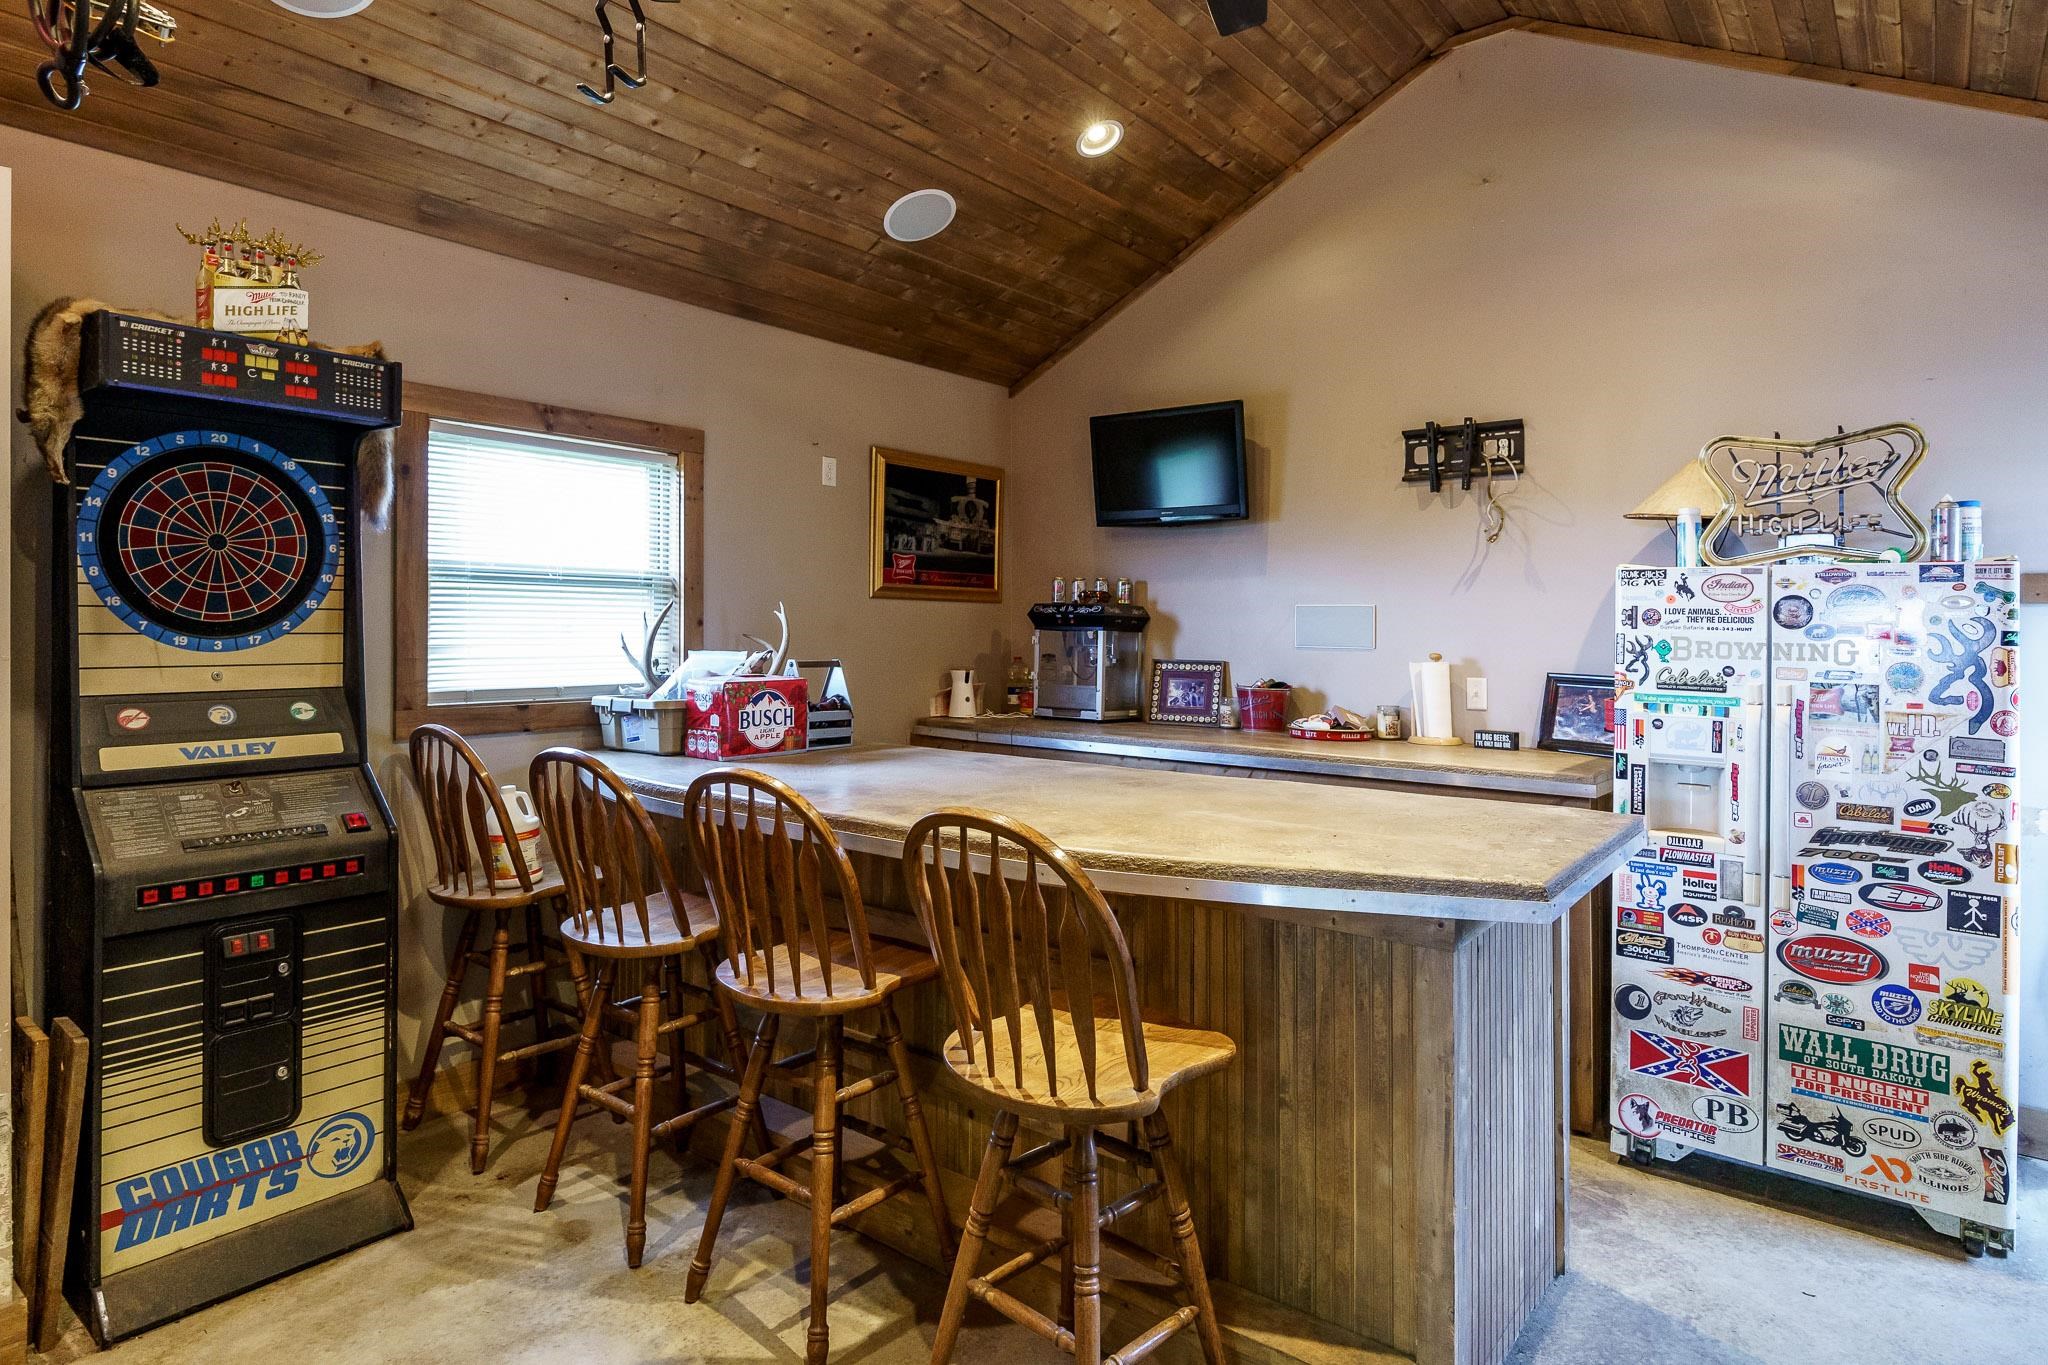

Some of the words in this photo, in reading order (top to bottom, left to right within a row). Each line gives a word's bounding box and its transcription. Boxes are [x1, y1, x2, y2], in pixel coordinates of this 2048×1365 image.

[225, 304, 264, 317] HIGH
[267, 304, 298, 316] LIFE
[130, 322, 174, 335] CRICKET
[341, 359, 376, 370] CRICKET
[176, 434, 184, 444] 5
[211, 434, 228, 443] 20
[135, 446, 150, 456] 12
[253, 444, 259, 452] 1
[282, 461, 295, 471] 18
[107, 468, 118, 478] 9
[1732, 450, 1901, 499] Miller
[308, 486, 317, 495] 4
[85, 497, 102, 506] 14
[321, 513, 334, 523] 13
[79, 532, 93, 541] 11
[329, 544, 337, 553] 6
[89, 566, 98, 576] 8
[321, 574, 334, 583] 10
[1706, 579, 1749, 590] Indian
[105, 596, 121, 606] 16
[304, 599, 318, 609] 15
[139, 621, 147, 630] 7
[282, 621, 290, 630] 2
[1717, 616, 1755, 624] DELICIOUS
[173, 636, 188, 645] 19
[214, 640, 222, 650] 3
[248, 635, 262, 644] 17
[1656, 667, 1727, 687] Cabela's
[739, 707, 794, 730] BUSCH
[1305, 730, 1317, 738] LIFE
[1887, 721, 1906, 736] WE
[753, 732, 781, 741] APPLE
[178, 741, 277, 760] VALLEY
[1907, 801, 1932, 814] DAM
[1661, 848, 1713, 863] FLOWMASTER
[1797, 847, 1881, 862] 700
[1815, 865, 1855, 879] muzzy
[1928, 861, 1964, 876] Holley
[1682, 878, 1717, 892] Holley
[1683, 891, 1717, 900] EQUIPPED
[1677, 914, 1704, 924] MSR
[1790, 944, 1874, 973] muzzy
[1826, 993, 1850, 1005] WALL
[1879, 990, 1914, 1002] muzzy
[1827, 1014, 1863, 1026] GoPro
[1926, 1000, 2004, 1028] SKYLINE
[1927, 1013, 2003, 1036] CAMOUFLAGE
[1780, 1023, 1858, 1064] WALL
[1870, 1042, 1948, 1083] DRUG
[1803, 1054, 1818, 1066] OF
[1825, 1059, 1865, 1075] SOUTH
[1871, 1069, 1923, 1088] DAKOTA
[1792, 1065, 1834, 1085] TED
[1837, 1074, 1929, 1106] NUGENT
[1795, 1078, 1830, 1095] FOR
[1833, 1084, 1925, 1115] PRESIDENT
[1965, 1087, 2012, 1116] Wyoming
[1705, 1097, 1749, 1128] PB
[1655, 1110, 1718, 1136] PREDATOR
[1655, 1121, 1717, 1145] TACTICS
[1867, 1123, 1916, 1142] SPUD
[1777, 1143, 1845, 1168] SKYJACKER
[1795, 1157, 1823, 1169] HYDRO
[1910, 1151, 1930, 1167] SOUTH
[1932, 1151, 1949, 1162] SIDE
[1951, 1154, 1976, 1176] RIDERS
[115, 1129, 304, 1215] COUGAR
[1983, 1149, 2007, 1203] Rage
[1844, 1174, 1890, 1193] FIRST
[1895, 1185, 1930, 1204] LITE
[1918, 1174, 1969, 1192] ILLINOIS
[113, 1165, 303, 1254] DARTS
